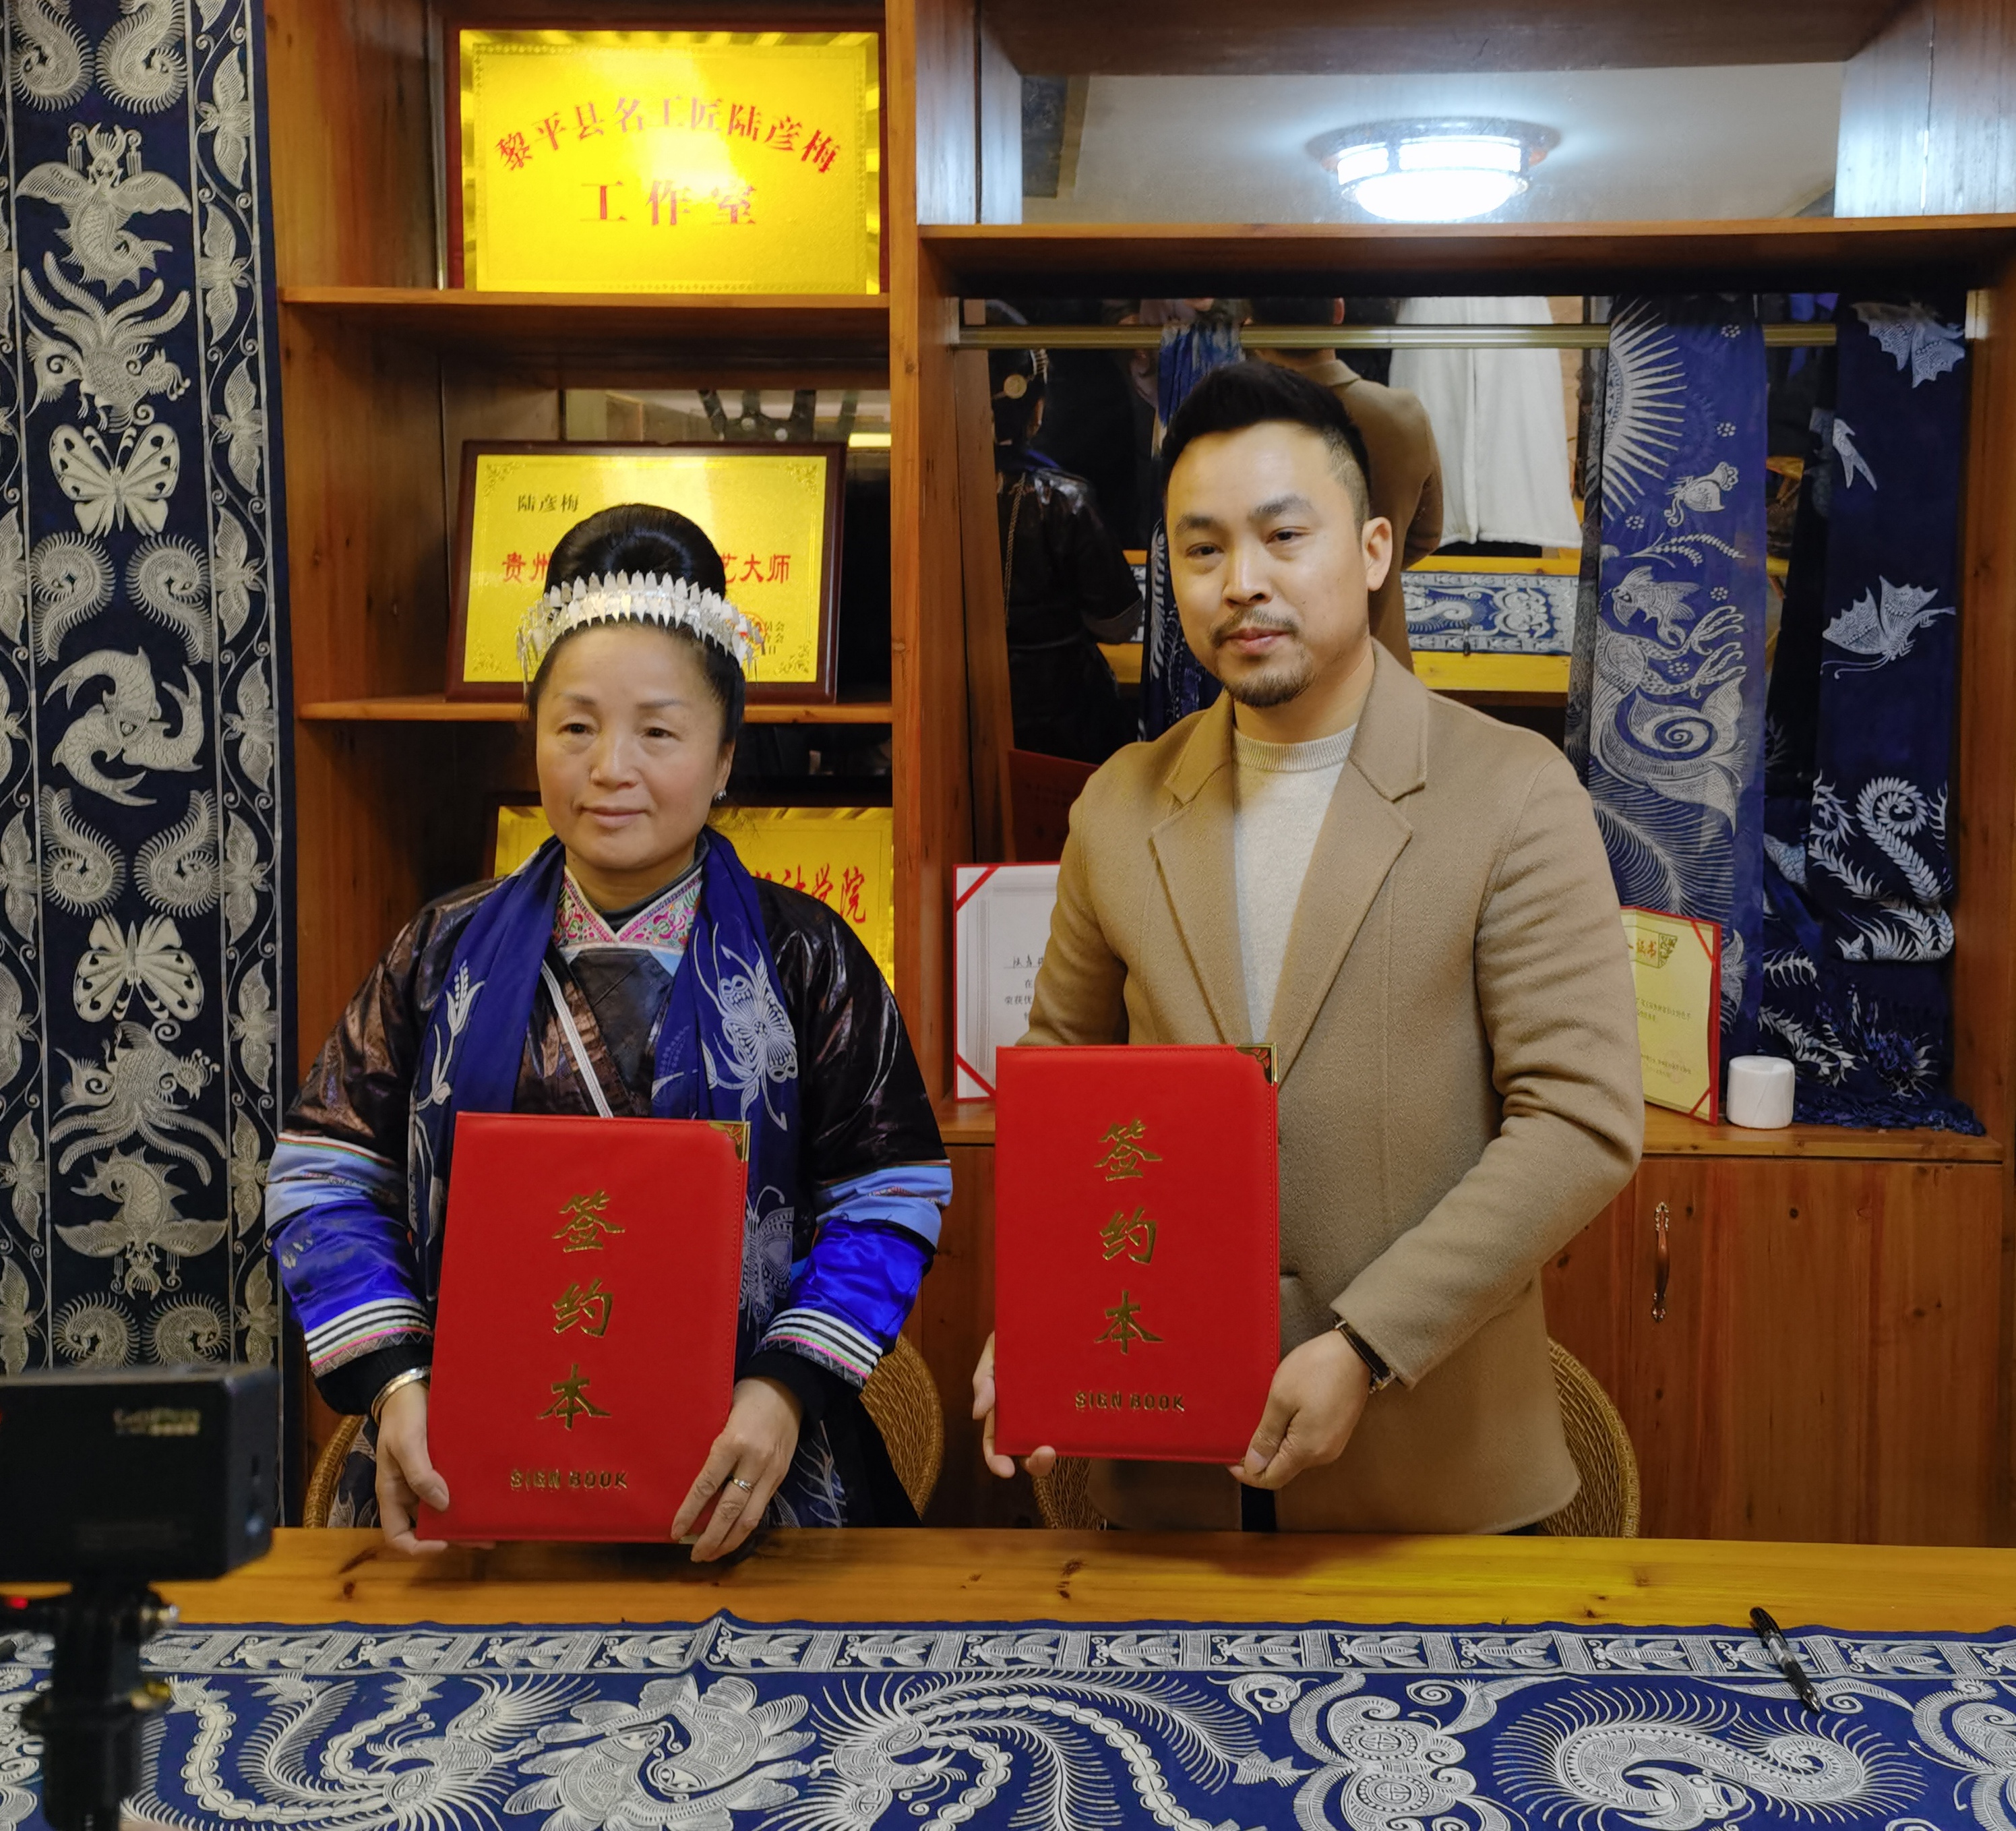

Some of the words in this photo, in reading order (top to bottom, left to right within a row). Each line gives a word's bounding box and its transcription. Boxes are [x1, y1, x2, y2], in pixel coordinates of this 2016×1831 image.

[495, 95, 841, 173] 黎平县名工匠陆彦梅
[580, 179, 756, 226] 工作室
[518, 493, 578, 512] 陆彦梅
[501, 551, 552, 583] 贵州
[721, 553, 791, 584] 艺大师
[1094, 1118, 1164, 1355] 签约本
[537, 1189, 625, 1431] 签约本
[1075, 1391, 1122, 1411] SIGN
[1130, 1393, 1185, 1412] BOOK
[510, 1470, 561, 1491] SIGN
[568, 1470, 628, 1490] BOOK
